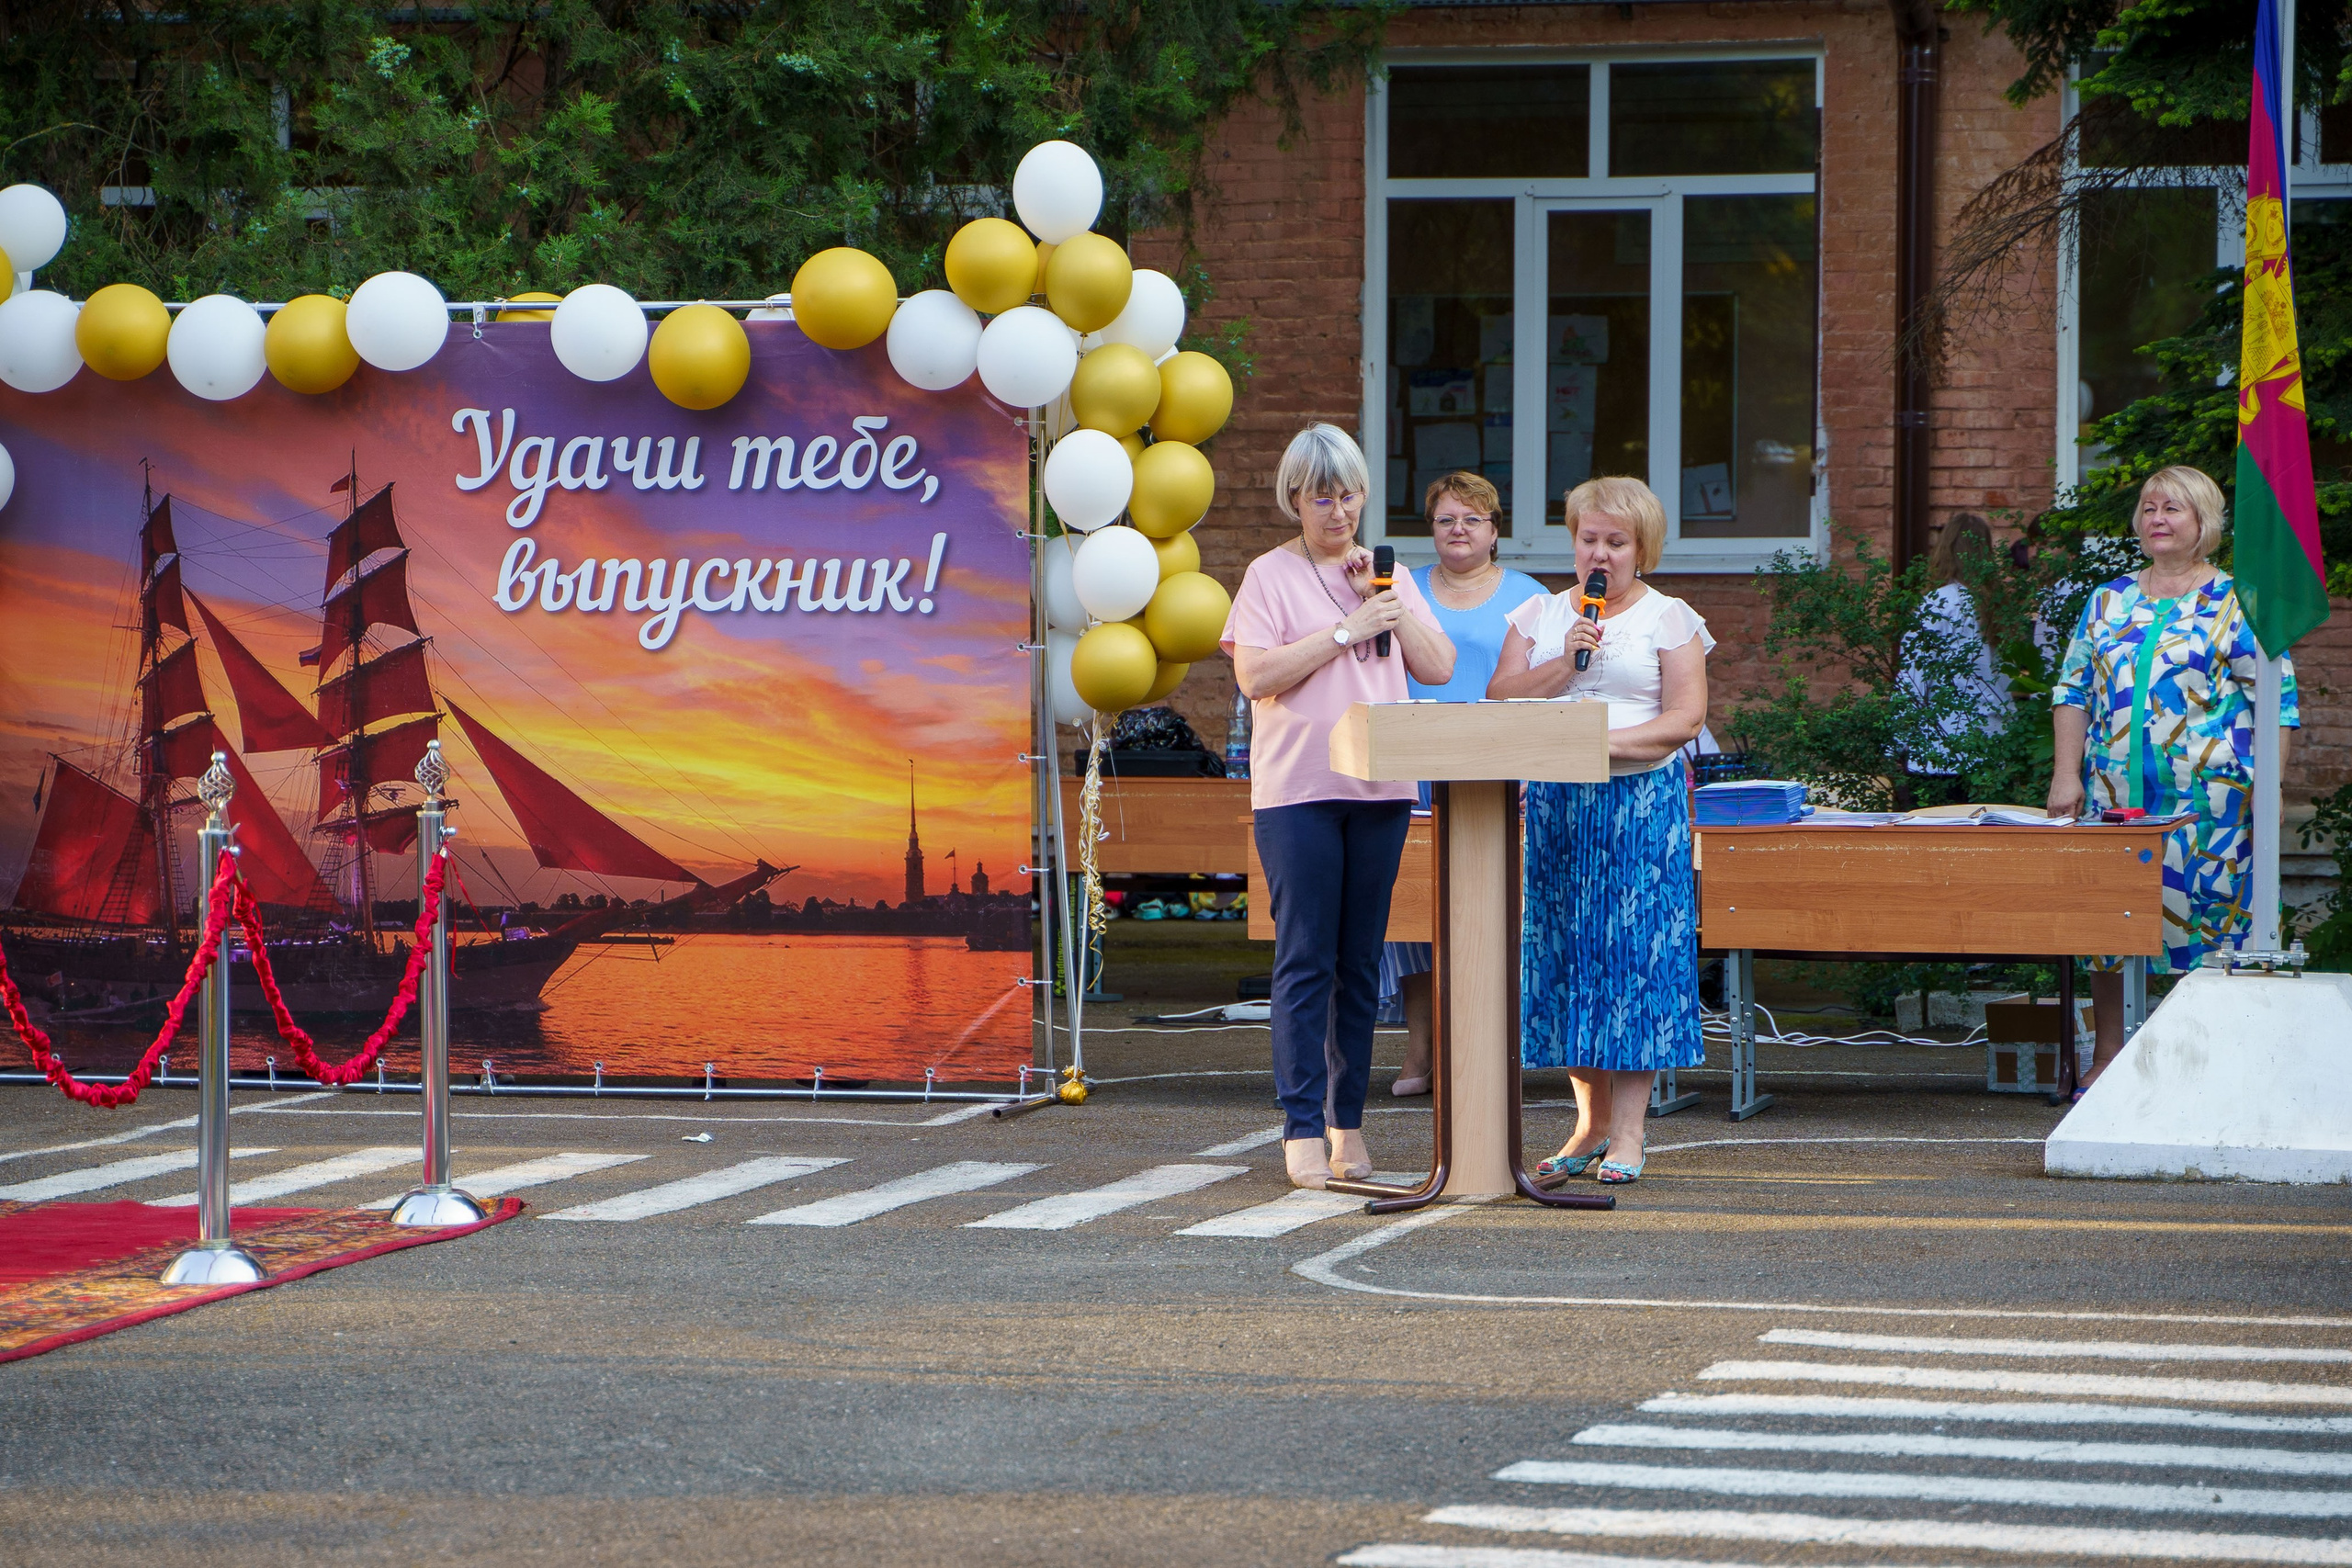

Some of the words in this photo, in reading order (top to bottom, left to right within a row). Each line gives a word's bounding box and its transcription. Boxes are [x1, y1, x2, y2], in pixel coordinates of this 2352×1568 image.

[451, 408, 705, 528] Удачи
[729, 415, 939, 503] тебе,
[492, 532, 947, 649] выпускник!
